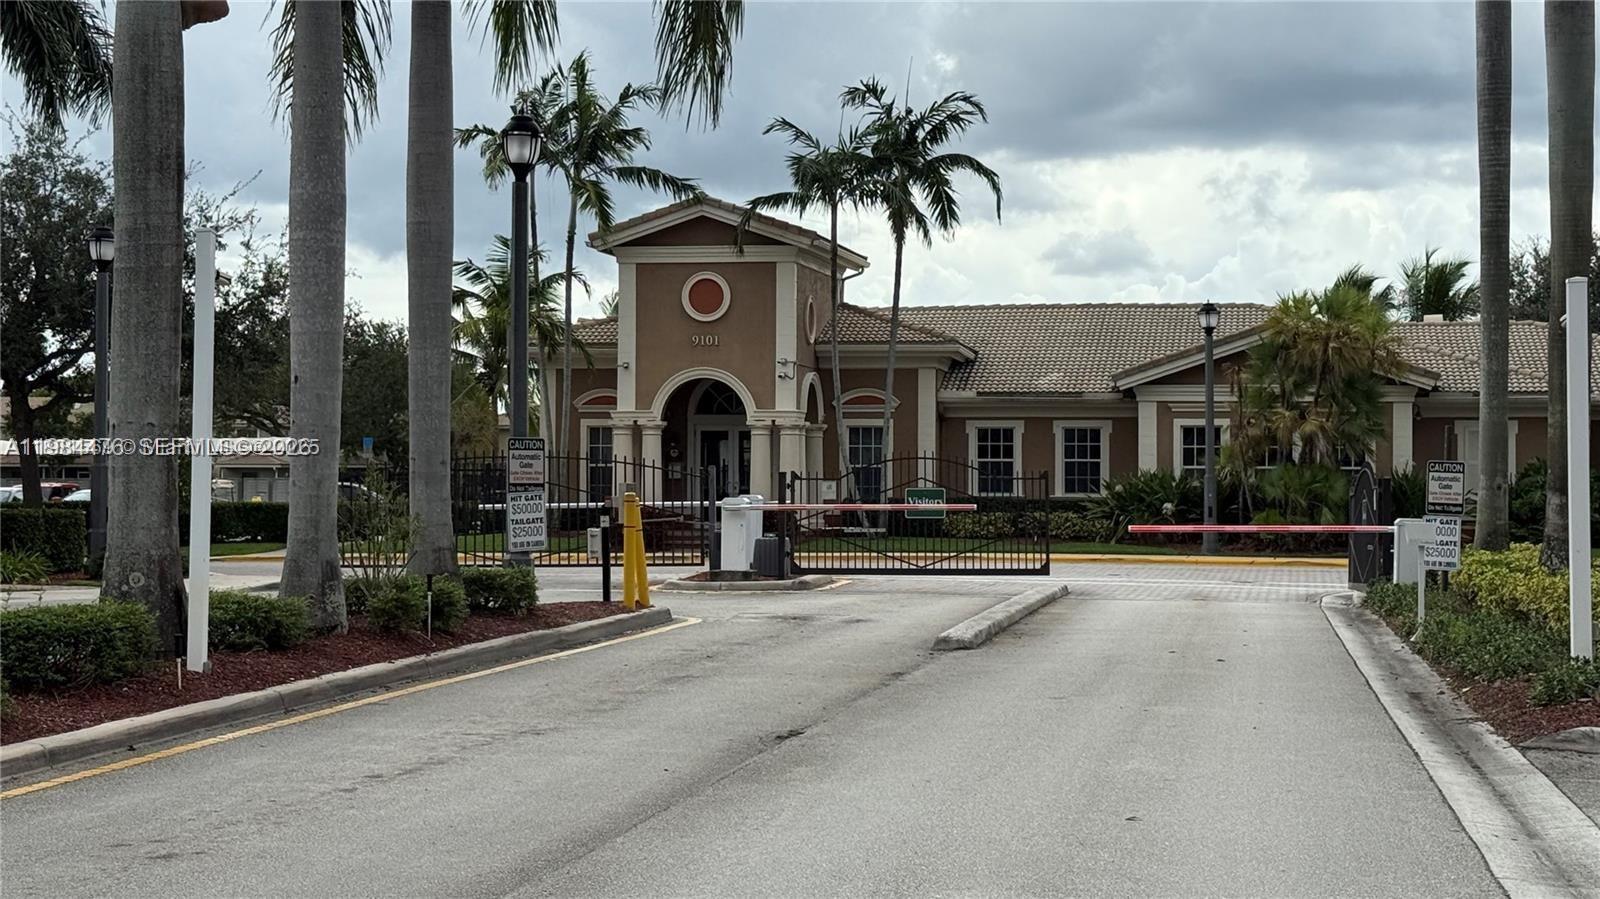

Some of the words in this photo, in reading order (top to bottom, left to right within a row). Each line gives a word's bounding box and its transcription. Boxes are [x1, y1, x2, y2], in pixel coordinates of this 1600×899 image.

[691, 335, 719, 346] 9101
[510, 440, 543, 449] CAUTION
[1429, 463, 1463, 472] CAUTION
[1438, 482, 1453, 490] Gate
[511, 517, 544, 525] TAILGATE
